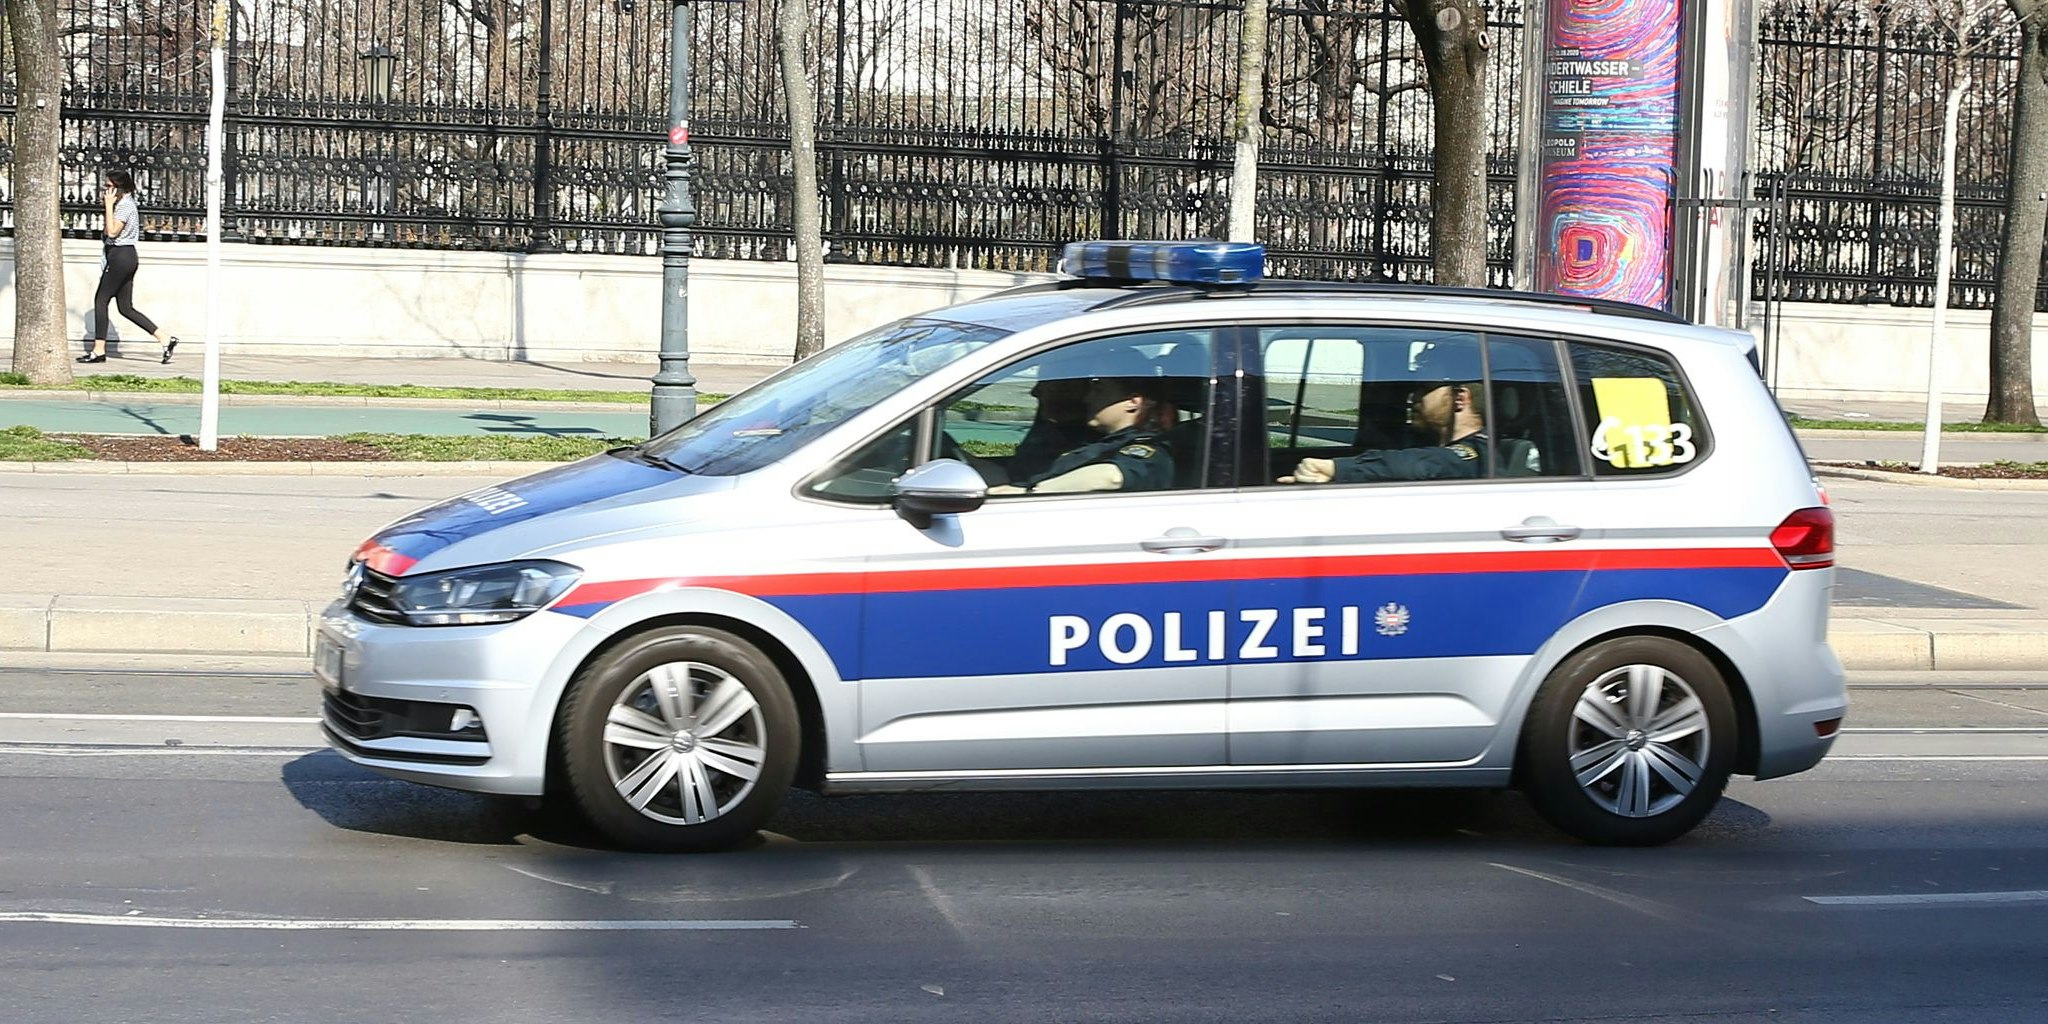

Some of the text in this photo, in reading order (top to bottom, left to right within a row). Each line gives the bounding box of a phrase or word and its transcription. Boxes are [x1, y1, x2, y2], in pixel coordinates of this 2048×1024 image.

[1545, 61, 1629, 76] NDERTWASSER
[1548, 80, 1591, 94] SCHIELE
[1572, 98, 1610, 106] TOMORROW
[1624, 422, 1697, 466] 133
[1048, 605, 1360, 666] POLIZEI
